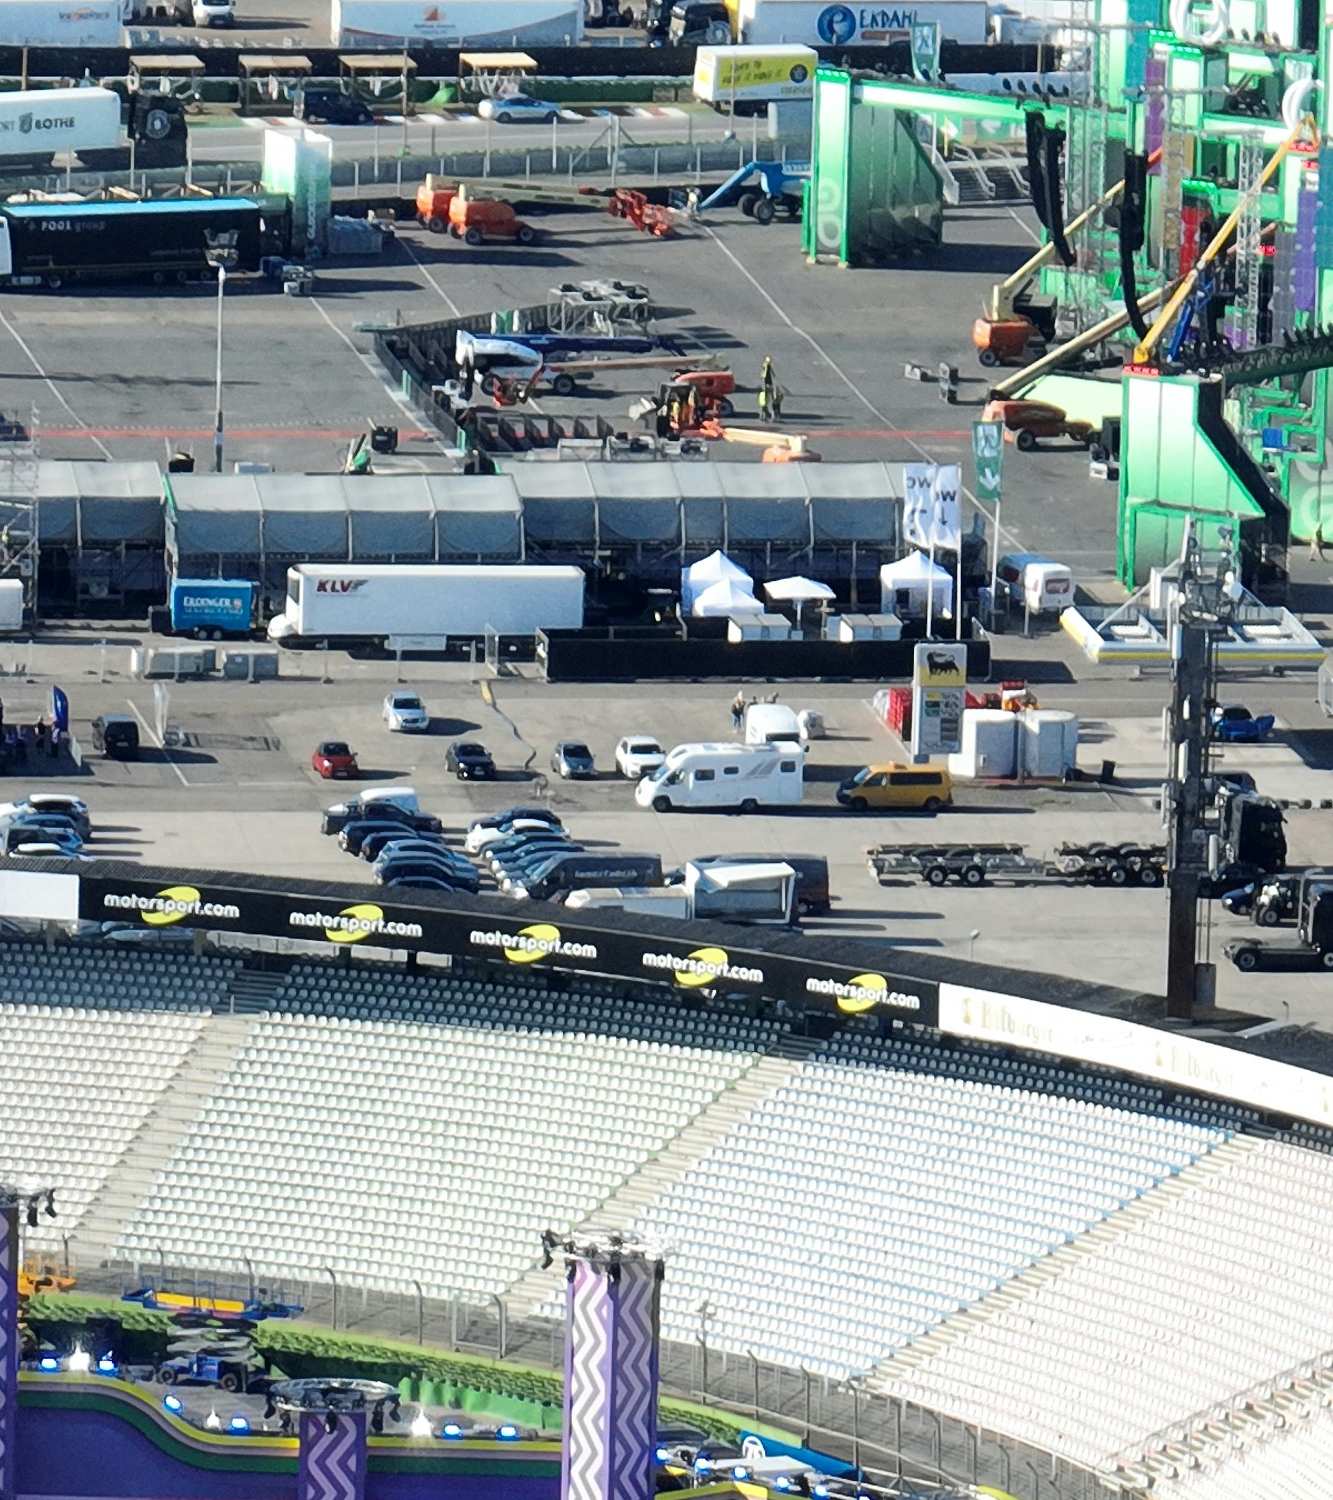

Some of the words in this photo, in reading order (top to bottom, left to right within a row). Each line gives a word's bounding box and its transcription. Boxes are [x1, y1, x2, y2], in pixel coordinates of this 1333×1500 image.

[35, 117, 75, 130] BOTHE
[316, 579, 353, 592] KLV
[104, 891, 241, 919] motorsport.com
[289, 910, 423, 940] motorsport.com
[470, 928, 598, 961] motorsport.com
[642, 950, 764, 984] motorsport.com
[806, 974, 921, 1012] motorsport.com
